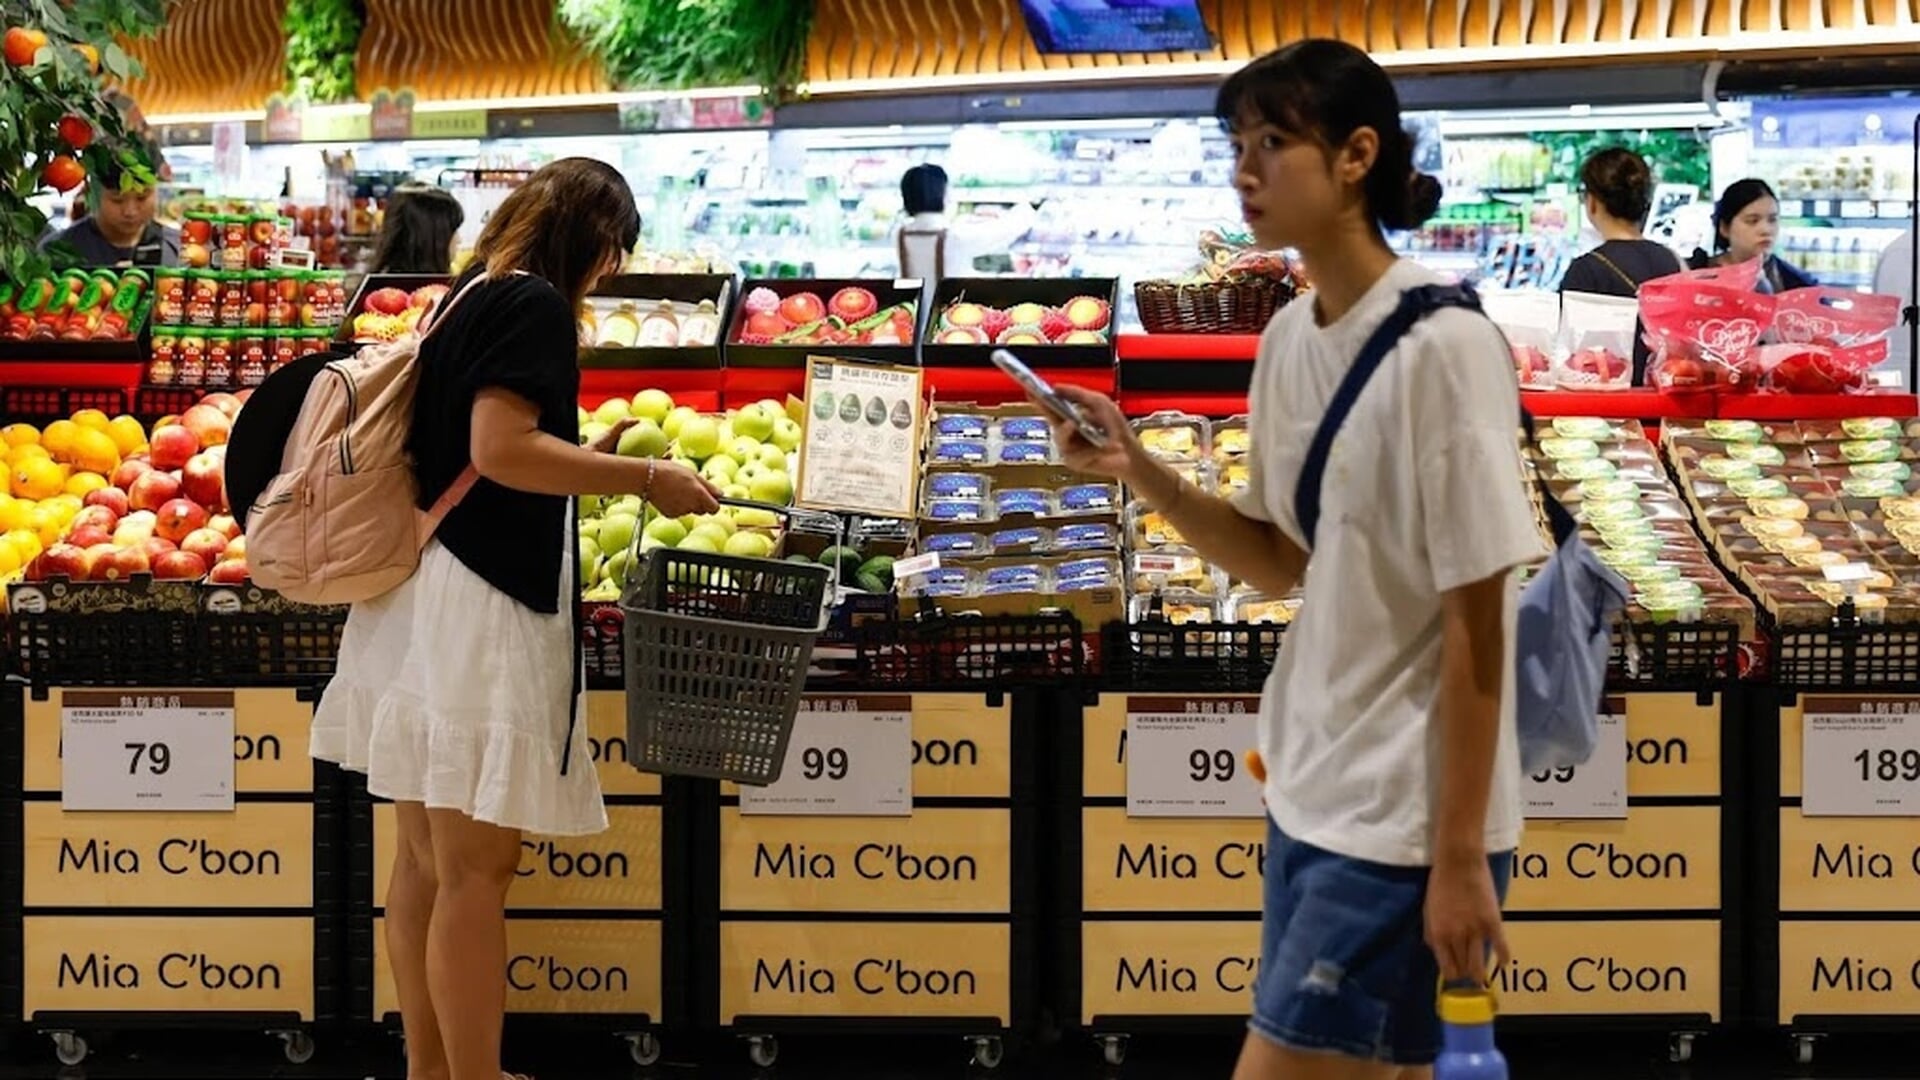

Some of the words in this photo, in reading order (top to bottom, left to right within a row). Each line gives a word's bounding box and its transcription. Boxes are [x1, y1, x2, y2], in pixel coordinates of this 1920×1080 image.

[125, 743, 171, 775] 79
[803, 748, 848, 780] 99
[1190, 749, 1235, 782] 99
[1855, 749, 1920, 782] 189
[59, 839, 138, 874] Mia
[158, 839, 280, 875] C'bon
[754, 843, 834, 879] Mia
[855, 843, 976, 880] C'bon
[1116, 843, 1197, 879] Mia
[1512, 847, 1548, 879] ia
[1567, 843, 1687, 879] C'bon
[1812, 843, 1892, 879] Mia
[58, 953, 138, 989] Mia
[158, 953, 280, 989] C'bon
[506, 955, 628, 992] C'bon
[754, 958, 834, 994] Mia
[854, 958, 976, 995] C'bon
[1116, 957, 1197, 993] Mia
[1566, 957, 1686, 993] C'bon
[1812, 957, 1892, 992] Mia
